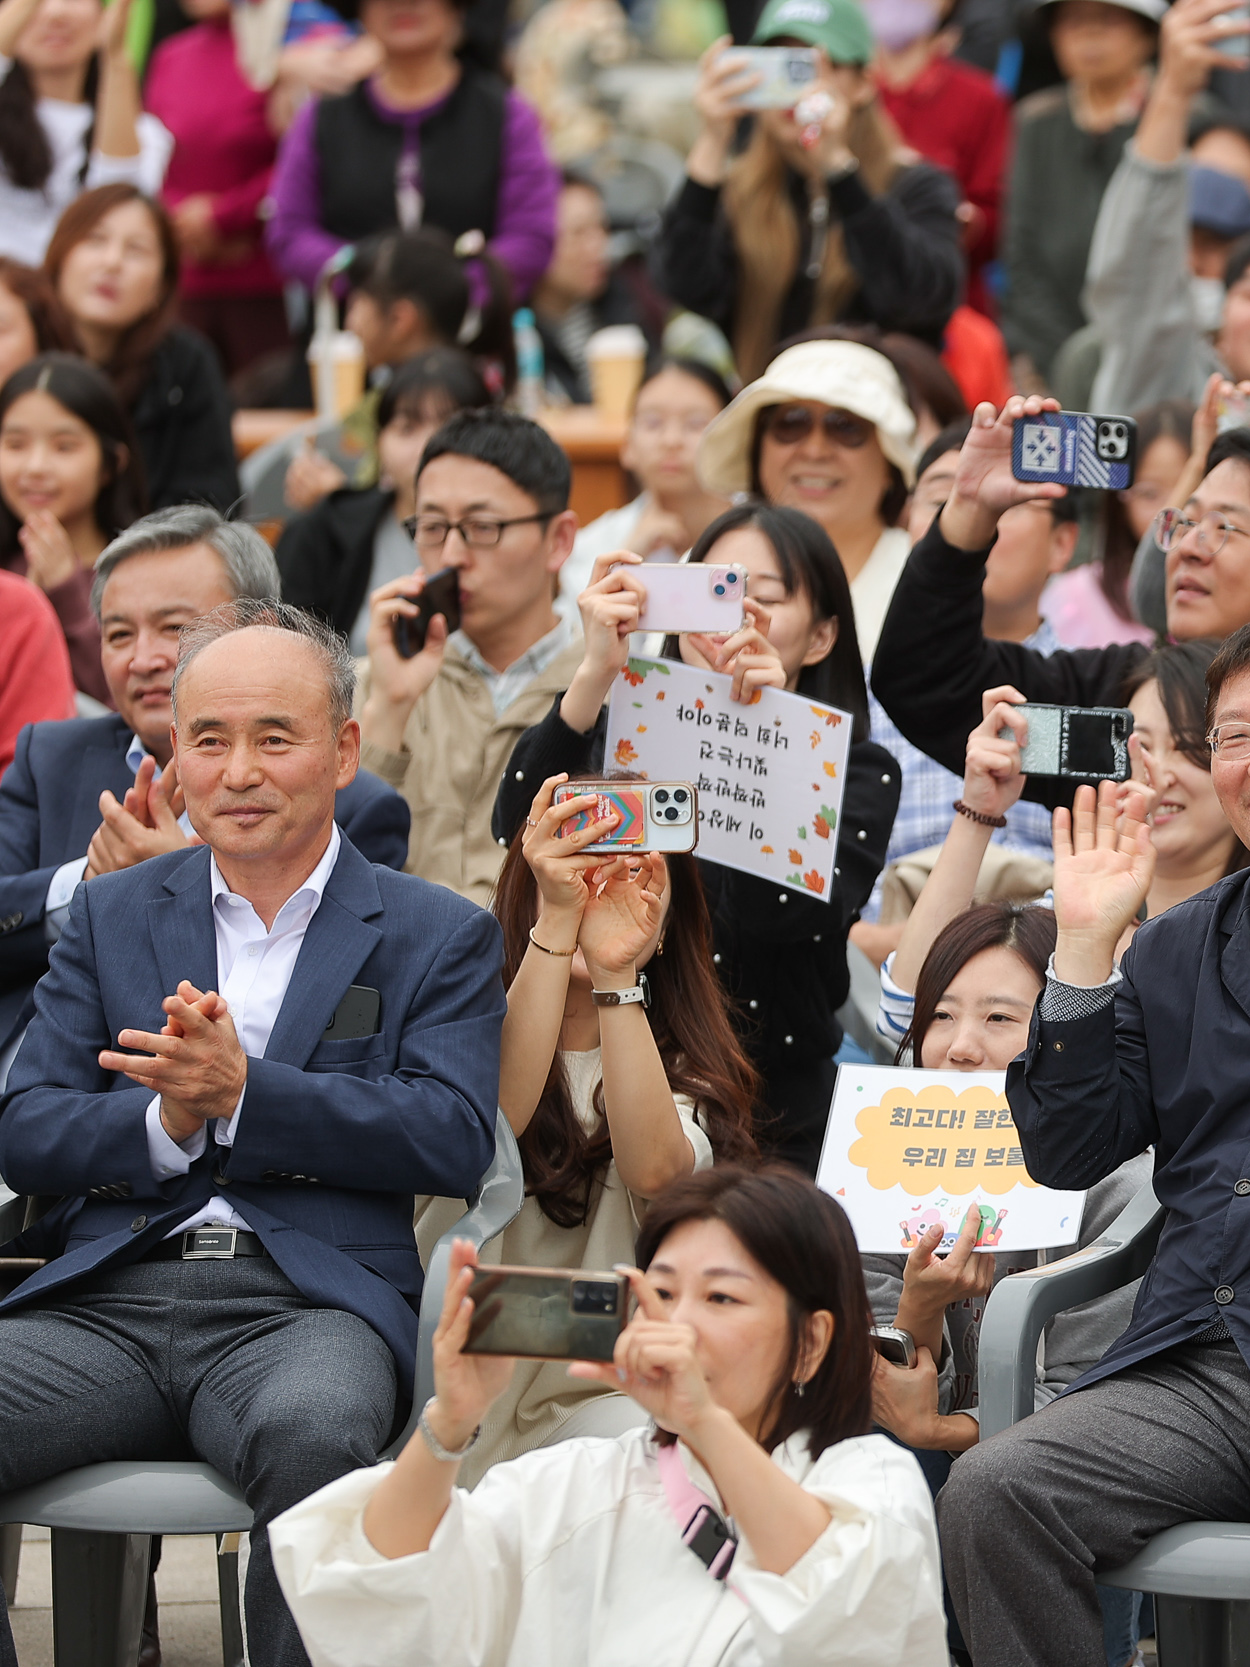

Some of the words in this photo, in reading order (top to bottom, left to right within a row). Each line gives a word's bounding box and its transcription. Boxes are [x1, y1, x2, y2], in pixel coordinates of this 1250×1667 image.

[676, 704, 749, 737] 덕분이야
[757, 725, 789, 750] 너희
[700, 741, 768, 776] 빛나는건
[695, 773, 766, 808] 반짝반짝
[749, 821, 764, 840] 이
[889, 1106, 966, 1129] 최고다!
[973, 1109, 1015, 1129] 잘한
[902, 1147, 947, 1168] 우리
[954, 1148, 977, 1168] 집
[983, 1147, 1025, 1167] 보물
